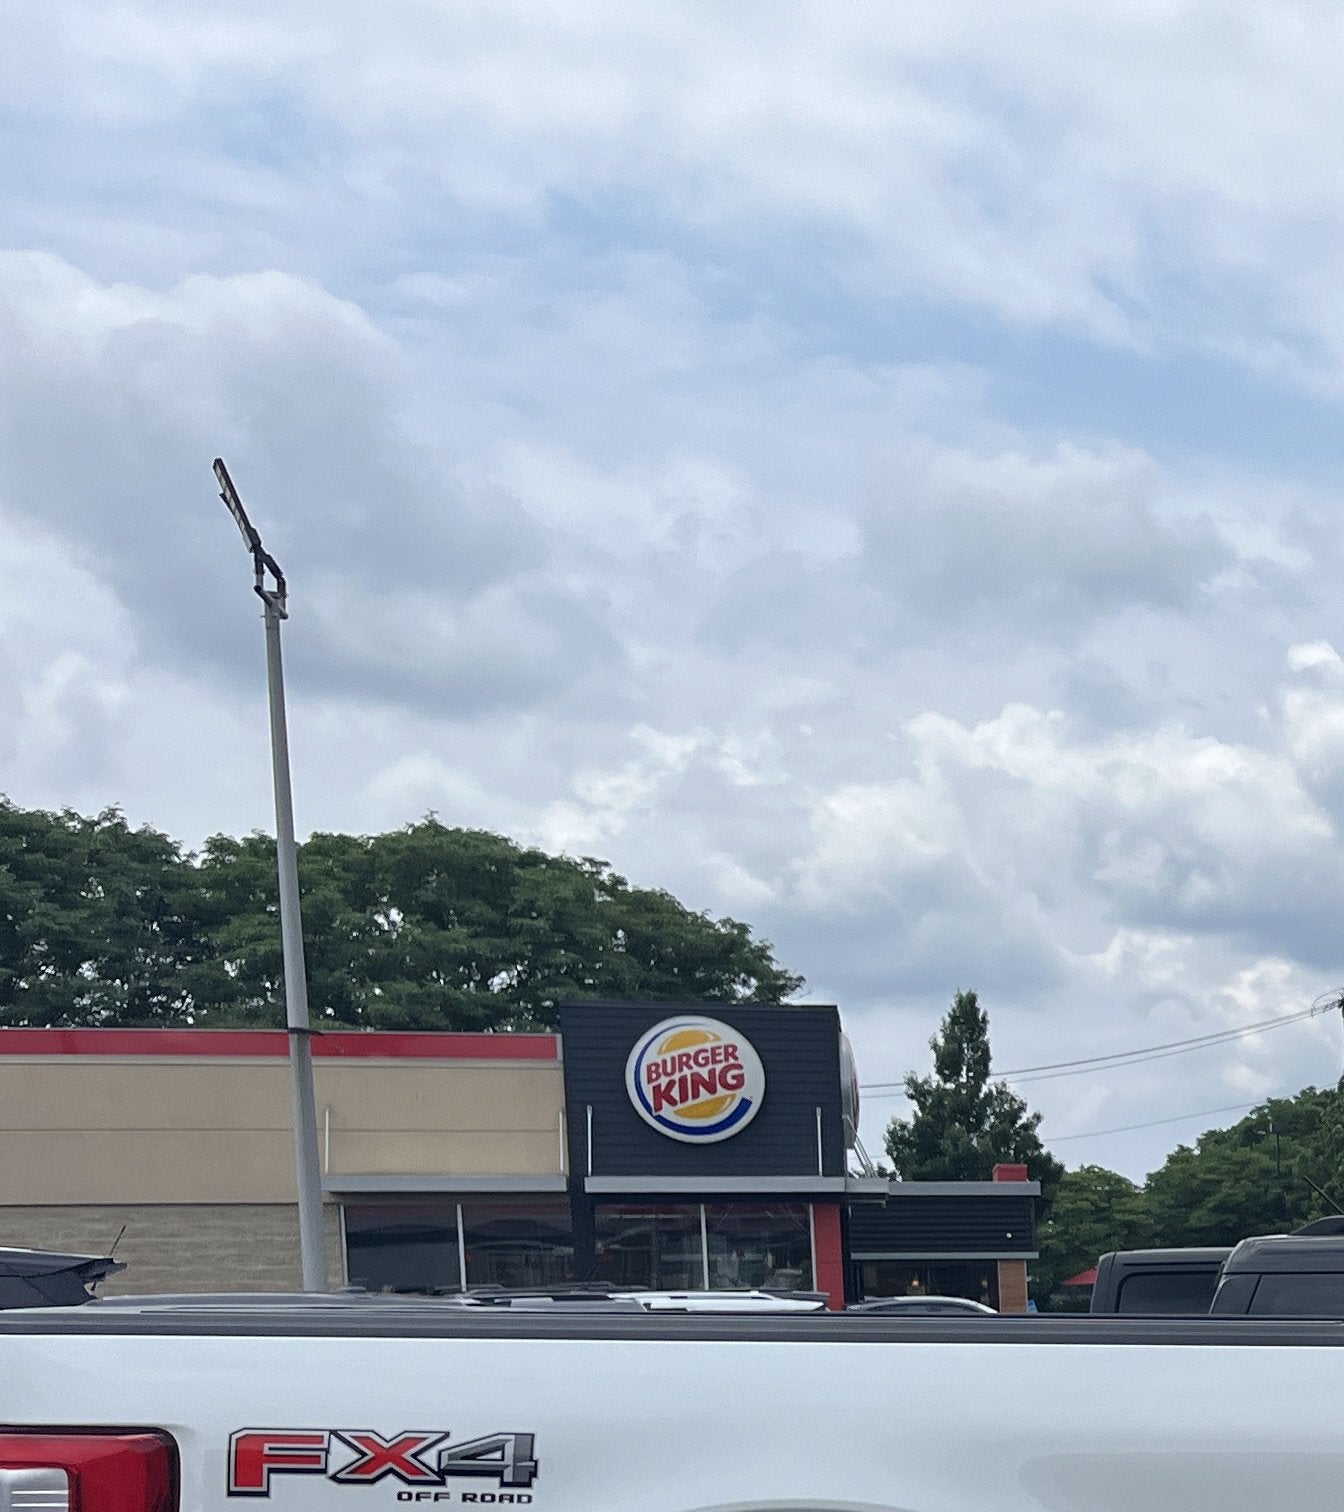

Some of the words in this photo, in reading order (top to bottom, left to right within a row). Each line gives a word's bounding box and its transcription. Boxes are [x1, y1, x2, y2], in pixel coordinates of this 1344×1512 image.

[646, 1043, 739, 1085] BURGER
[651, 1063, 746, 1113] KING
[227, 1427, 538, 1498] FX4
[397, 1491, 451, 1502] OFF
[461, 1492, 533, 1504] ROAD
